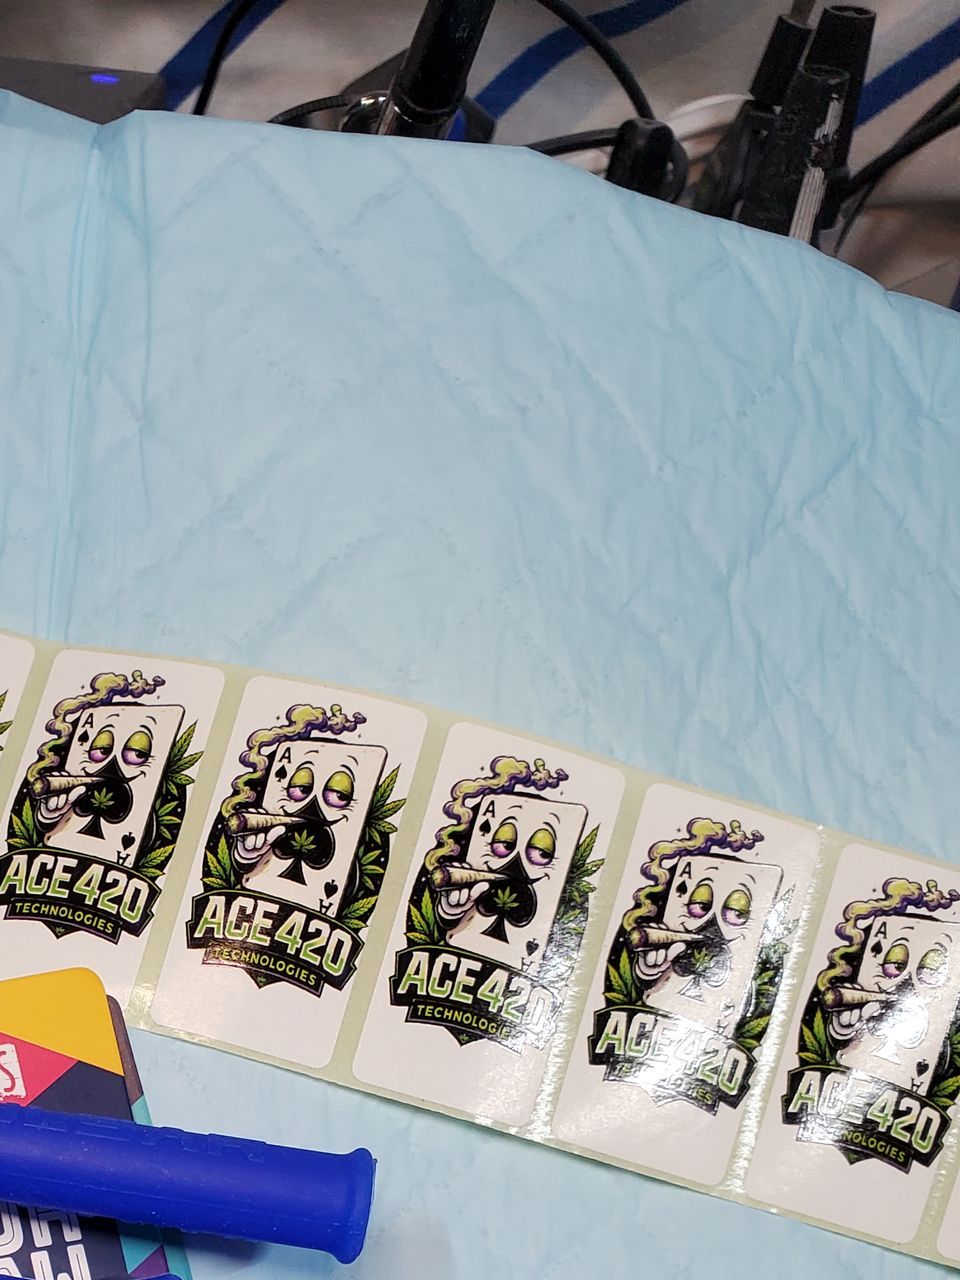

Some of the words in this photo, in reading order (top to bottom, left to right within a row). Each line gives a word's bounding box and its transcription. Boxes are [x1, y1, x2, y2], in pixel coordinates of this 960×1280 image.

[81, 713, 93, 728] A
[279, 747, 291, 763] A
[483, 800, 496, 818] A
[680, 862, 692, 879] A
[73, 863, 149, 923] 420
[15, 903, 113, 934] TECHNOLOGIES
[874, 921, 887, 938] A
[193, 896, 279, 946] ACE
[274, 911, 352, 976] 420
[214, 950, 317, 986] TECHNOLOGIES
[397, 951, 483, 1004] ACE
[477, 968, 553, 1034] 420
[417, 1005, 513, 1040] TECHNOLOGIE
[788, 1071, 870, 1124] ACE
[867, 1088, 941, 1153] 420
